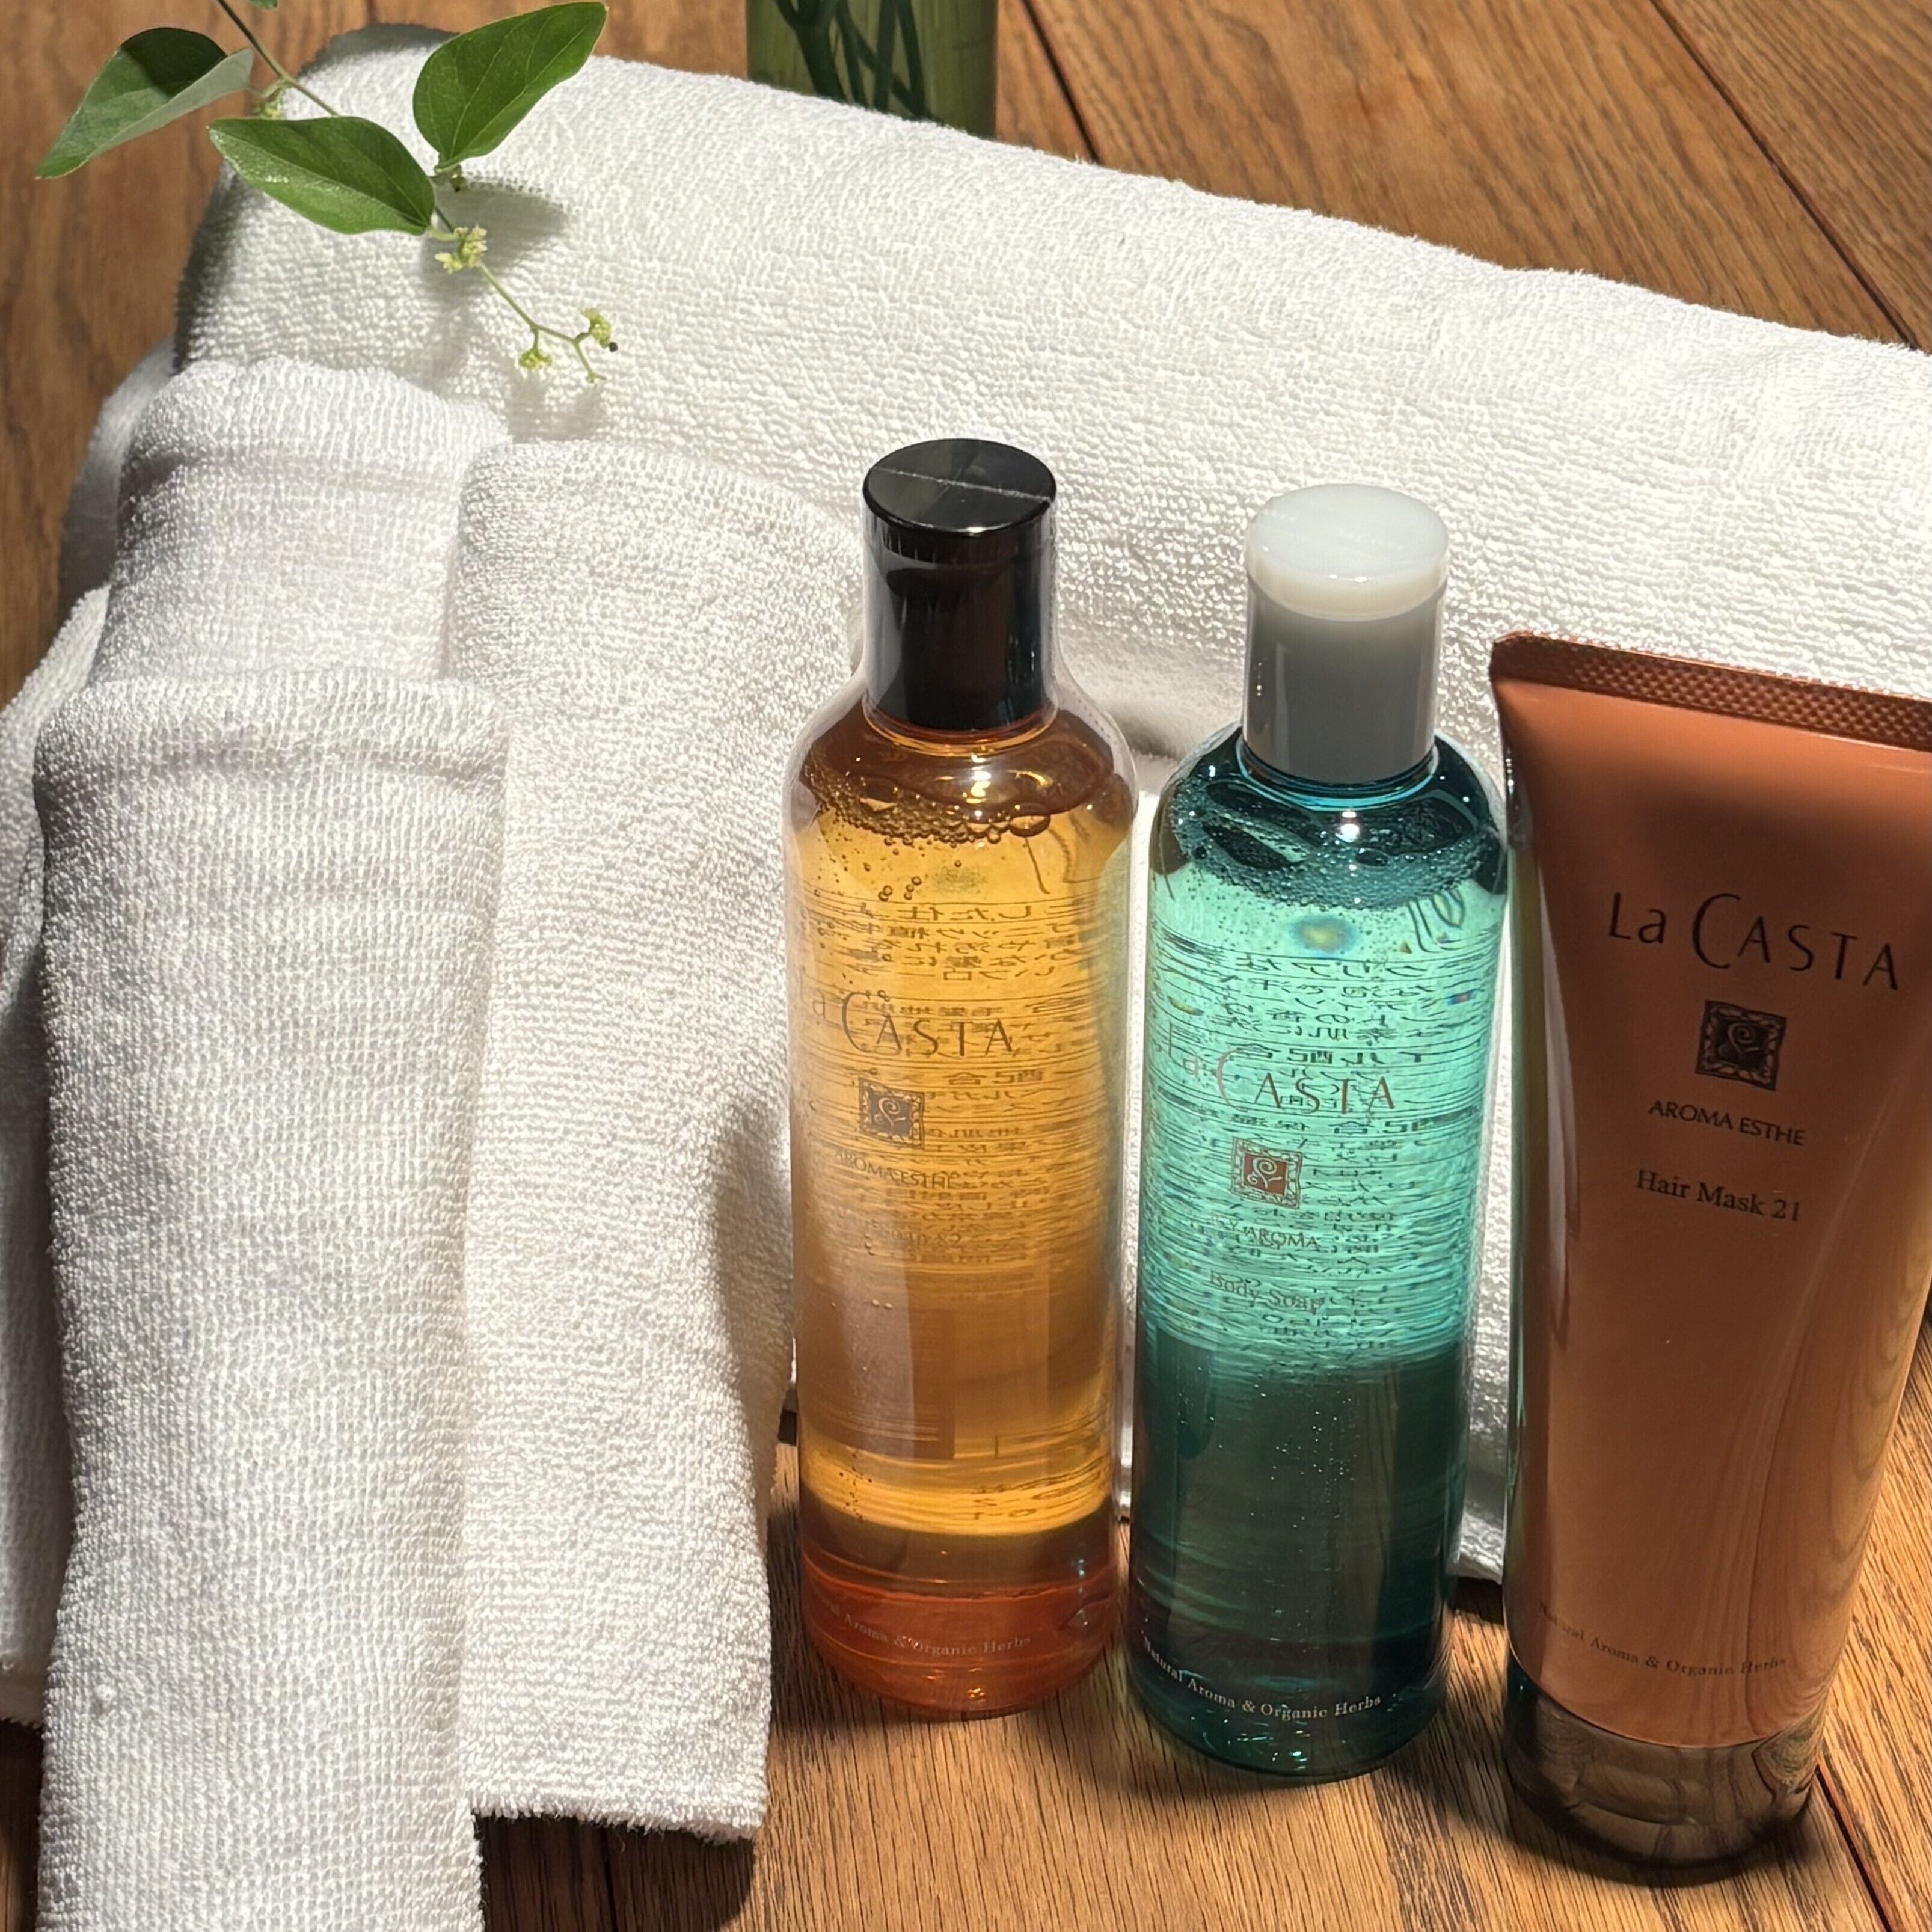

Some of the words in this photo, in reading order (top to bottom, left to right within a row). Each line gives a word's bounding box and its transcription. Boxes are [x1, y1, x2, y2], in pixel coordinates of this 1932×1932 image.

[1608, 892, 1667, 944] La
[1691, 892, 1898, 991] CASTA
[842, 990, 1013, 1057] CASTA
[1216, 1044, 1396, 1115] CASTA
[1648, 1099, 1734, 1130] AROMA
[1739, 1117, 1805, 1145] ESTHE
[1636, 1168, 1690, 1198] Hair
[1696, 1182, 1765, 1216] Mask
[1771, 1199, 1800, 1222] 21
[1590, 1636, 1639, 1666] Aroma
[1644, 1655, 1660, 1670] &
[1666, 1658, 1734, 1678] Organic
[1187, 1677, 1236, 1709] Aroma
[1241, 1699, 1256, 1714] &
[1260, 1702, 1329, 1722] Organic
[1333, 1694, 1382, 1717] Herbs
